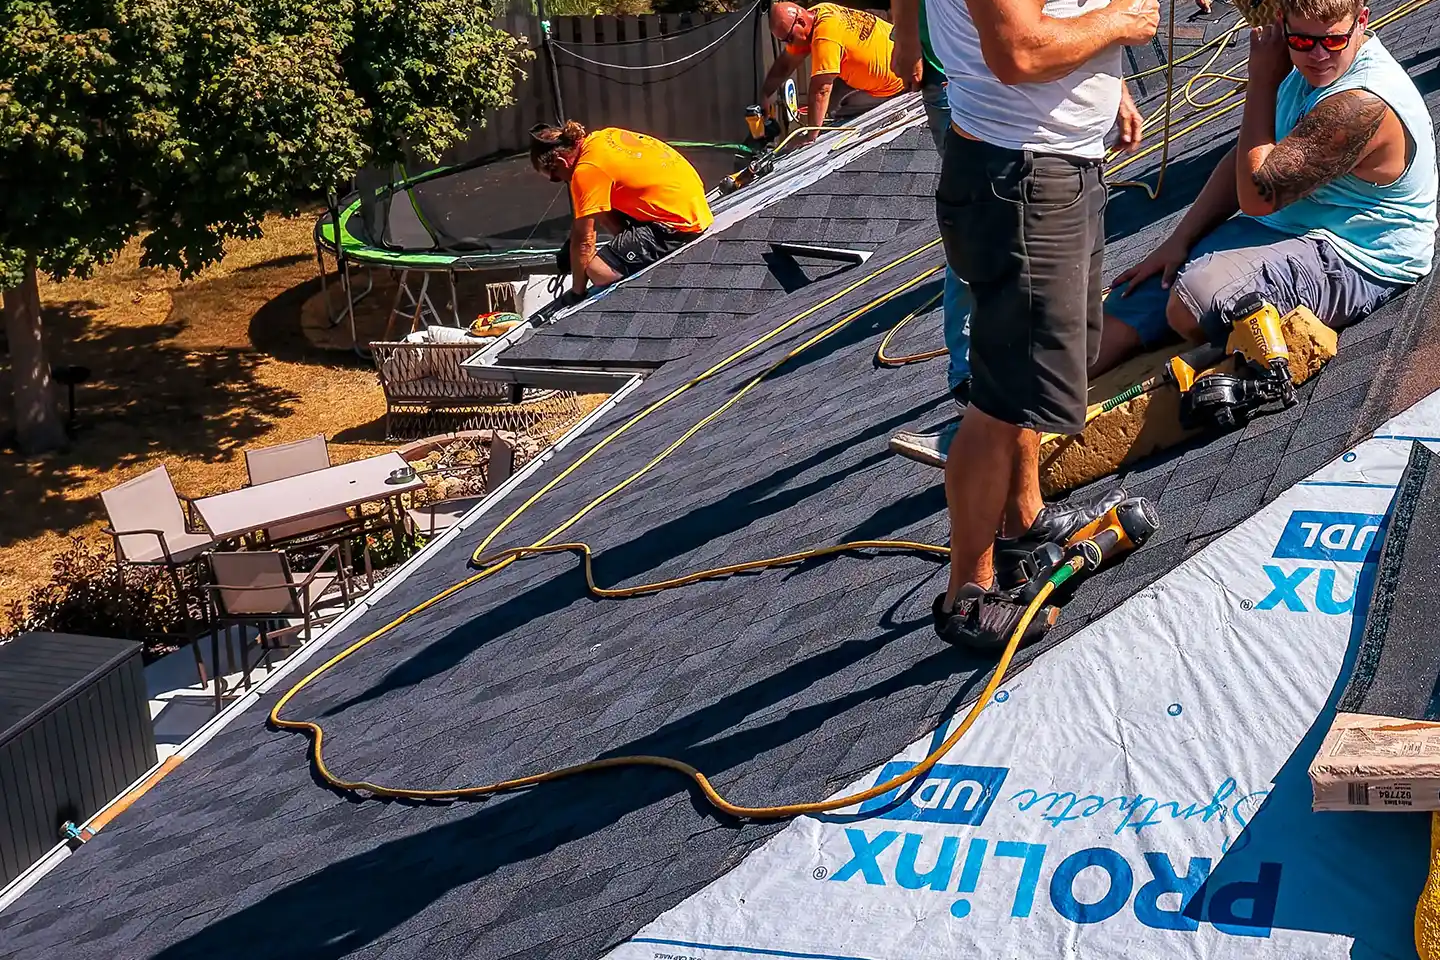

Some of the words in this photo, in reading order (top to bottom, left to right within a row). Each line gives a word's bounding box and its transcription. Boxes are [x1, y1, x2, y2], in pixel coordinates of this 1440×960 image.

[1250, 318, 1271, 356] BOSTITCH
[1009, 777, 1273, 854] Synthetic
[1379, 791, 1412, 800] 627784
[827, 828, 1283, 939] PROLinx
